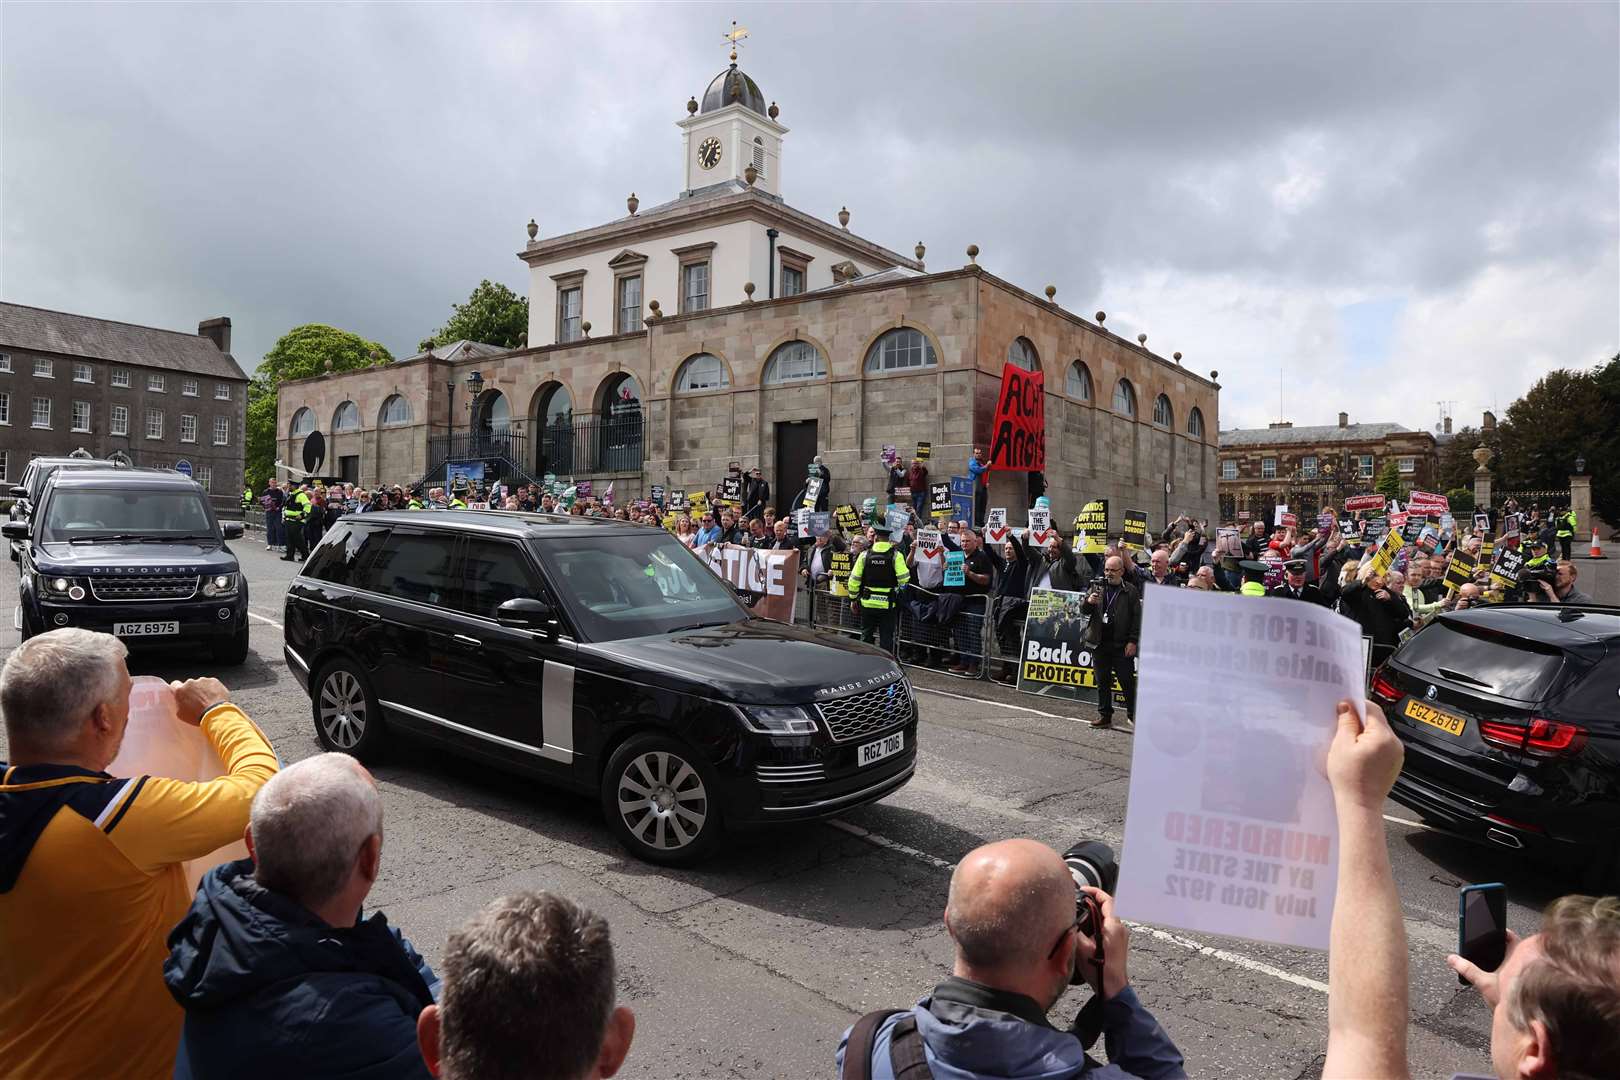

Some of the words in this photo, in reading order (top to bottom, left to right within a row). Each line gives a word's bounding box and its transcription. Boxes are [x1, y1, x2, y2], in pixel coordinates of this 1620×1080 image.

[932, 485, 949, 494] Back
[936, 493, 946, 501] off
[931, 500, 951, 510] Boris!
[1078, 513, 1090, 521] OFF
[1091, 513, 1106, 521] THE
[1076, 522, 1107, 530] PROTOCOL!
[918, 541, 937, 549] NOW
[1503, 550, 1524, 564] Back
[1504, 560, 1517, 570] off
[1494, 565, 1519, 580] Boris!
[119, 624, 142, 635] AGZ
[144, 622, 175, 634] 6975
[1027, 640, 1073, 665] Back
[1026, 664, 1088, 685] PROTECT
[820, 681, 863, 695] RANGE
[867, 670, 898, 685] ROVER
[1409, 702, 1430, 720] FGZ
[1430, 711, 1460, 731] 2678
[864, 741, 882, 762] RGZ
